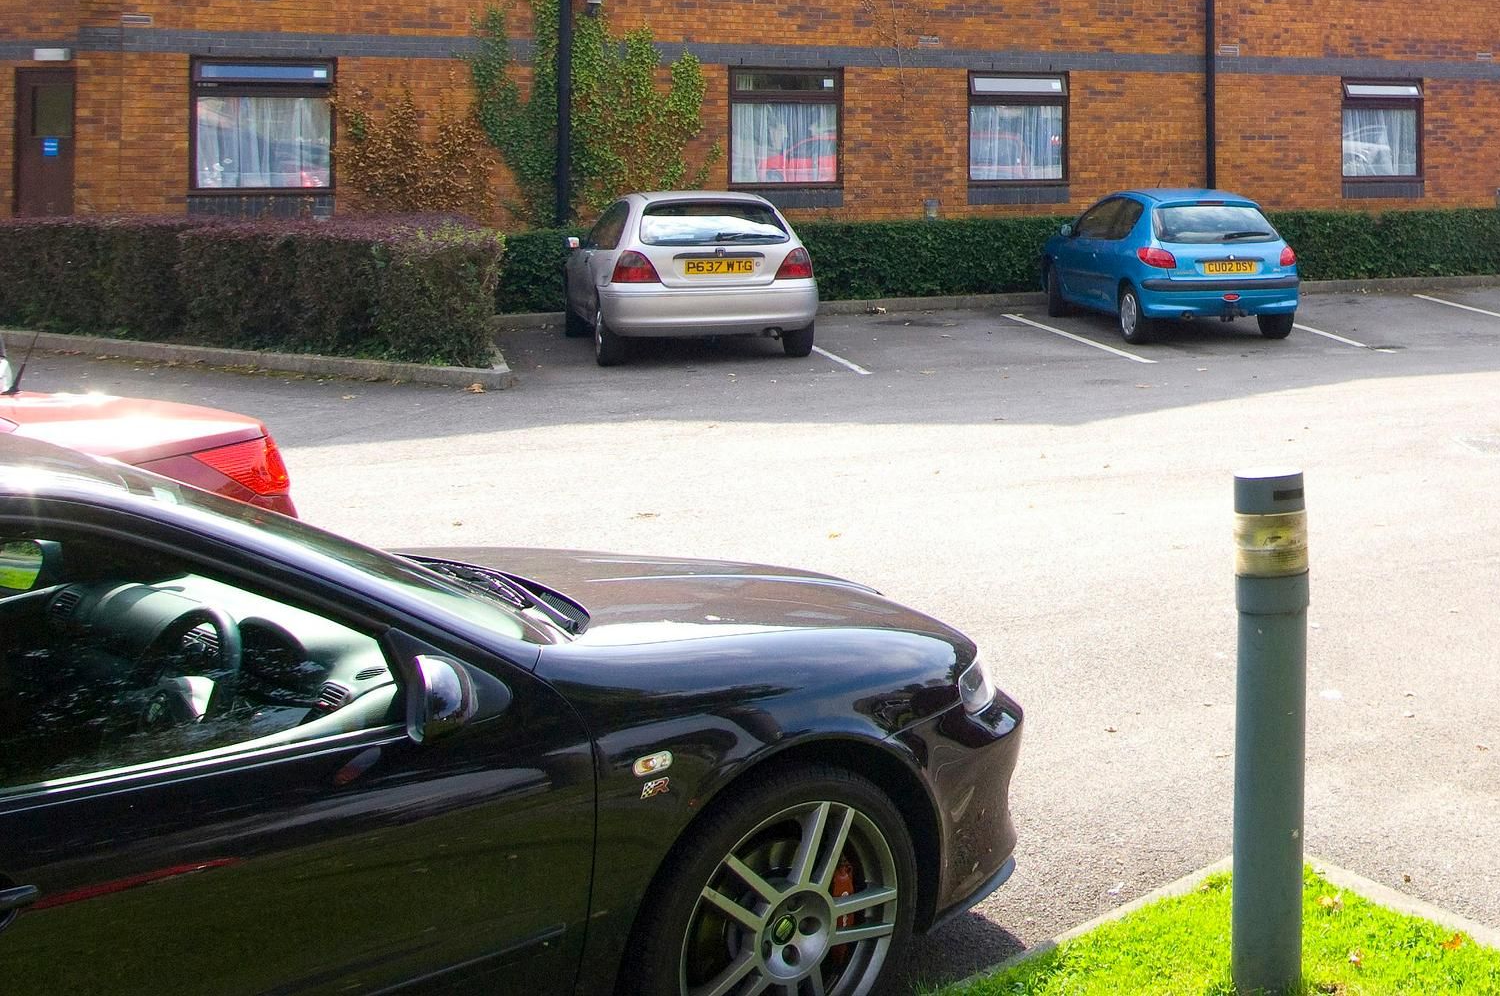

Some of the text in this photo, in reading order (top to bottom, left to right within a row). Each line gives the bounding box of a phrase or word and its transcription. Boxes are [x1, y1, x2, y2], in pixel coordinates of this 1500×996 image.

[687, 260, 753, 272] P637 WTG
[1208, 262, 1254, 272] CU02 DSY
